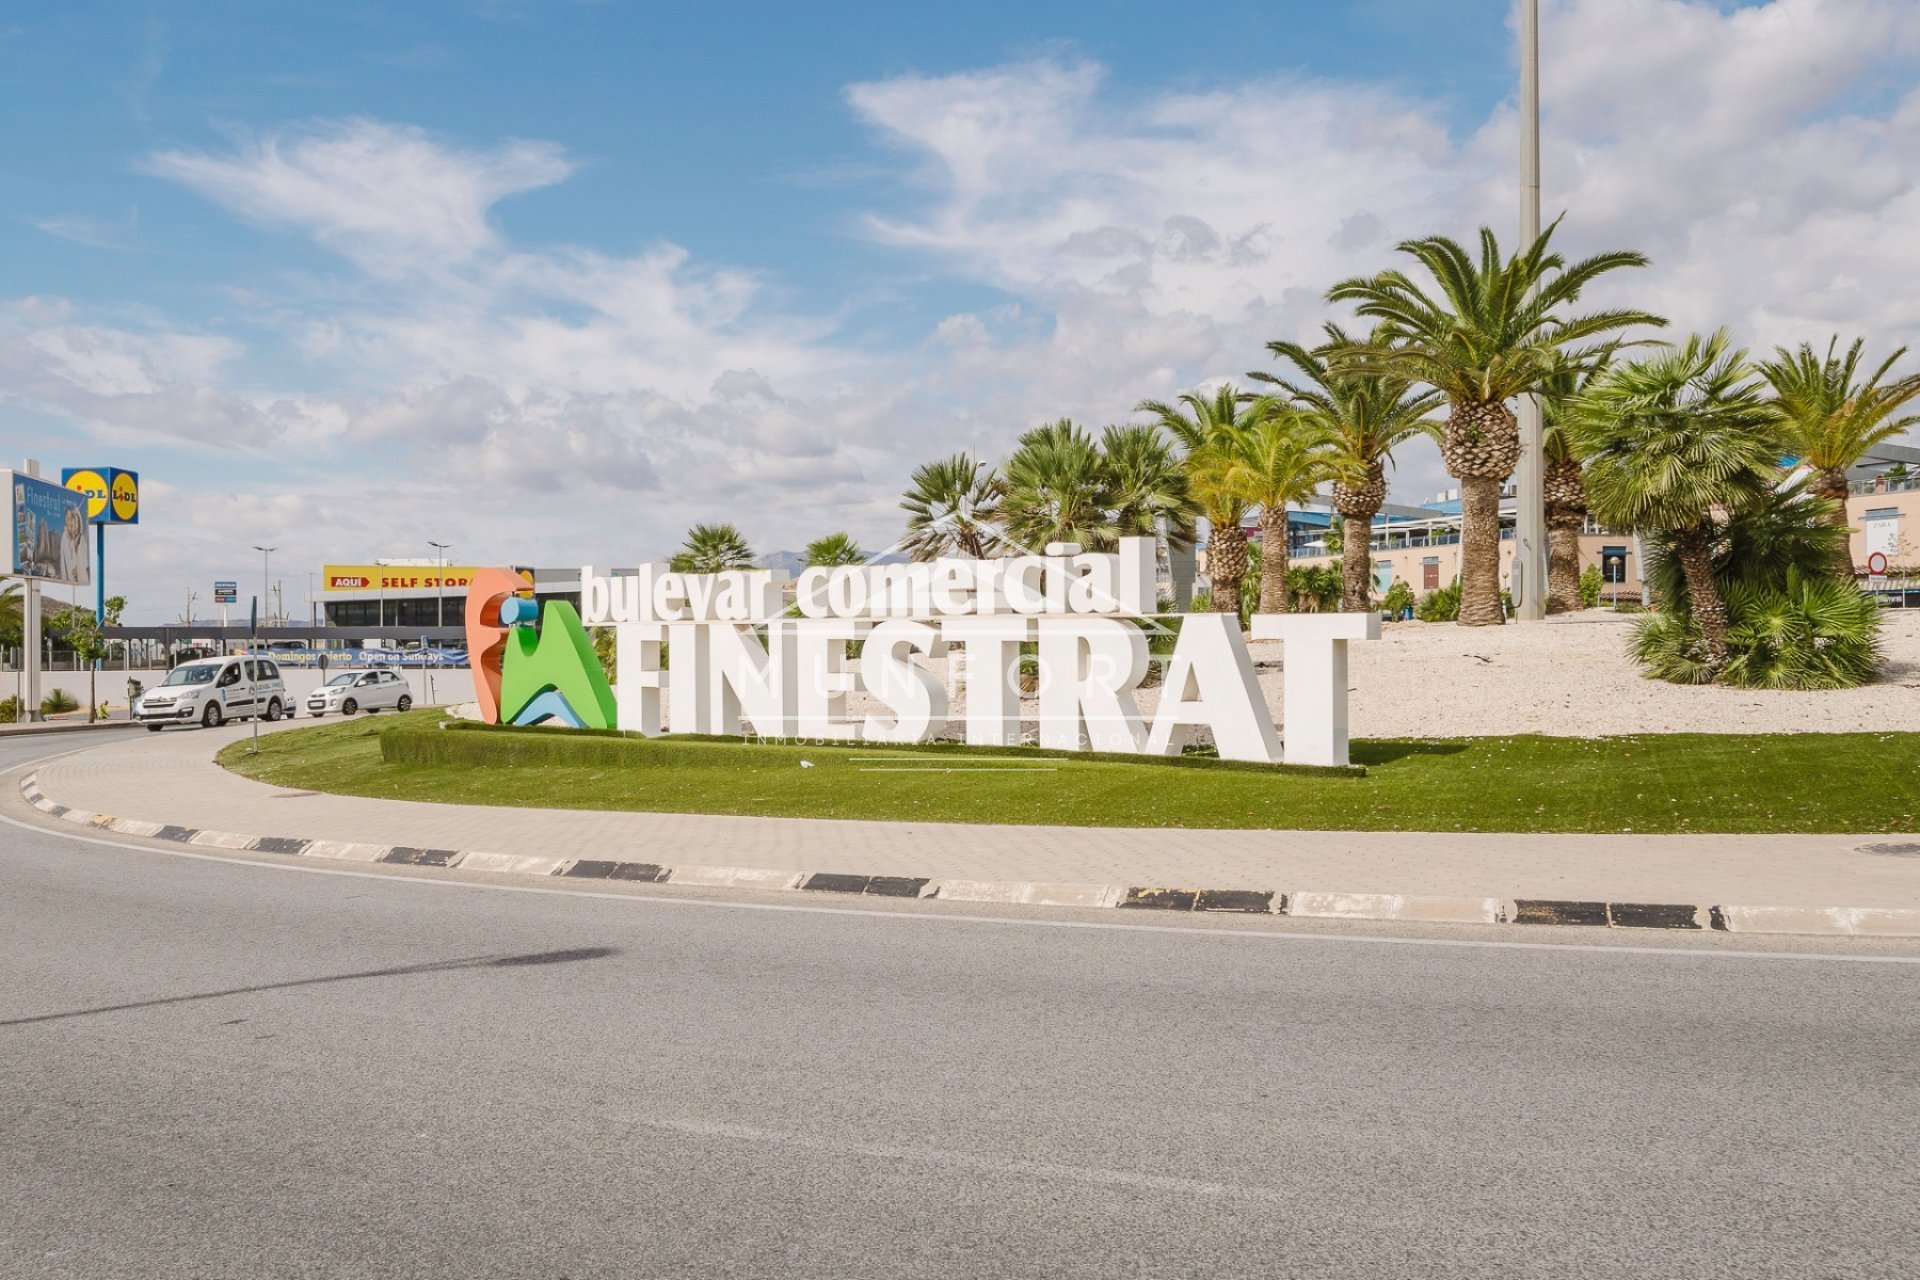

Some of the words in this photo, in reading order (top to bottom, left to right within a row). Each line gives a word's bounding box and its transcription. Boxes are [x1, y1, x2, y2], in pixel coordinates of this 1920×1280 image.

[382, 577, 418, 588] SELF
[424, 577, 474, 588] STOR
[581, 563, 782, 623] bulevar
[796, 536, 1157, 618] comercial
[359, 652, 386, 662] Open
[388, 653, 400, 661] on
[616, 611, 1382, 767] FINESTRAT
